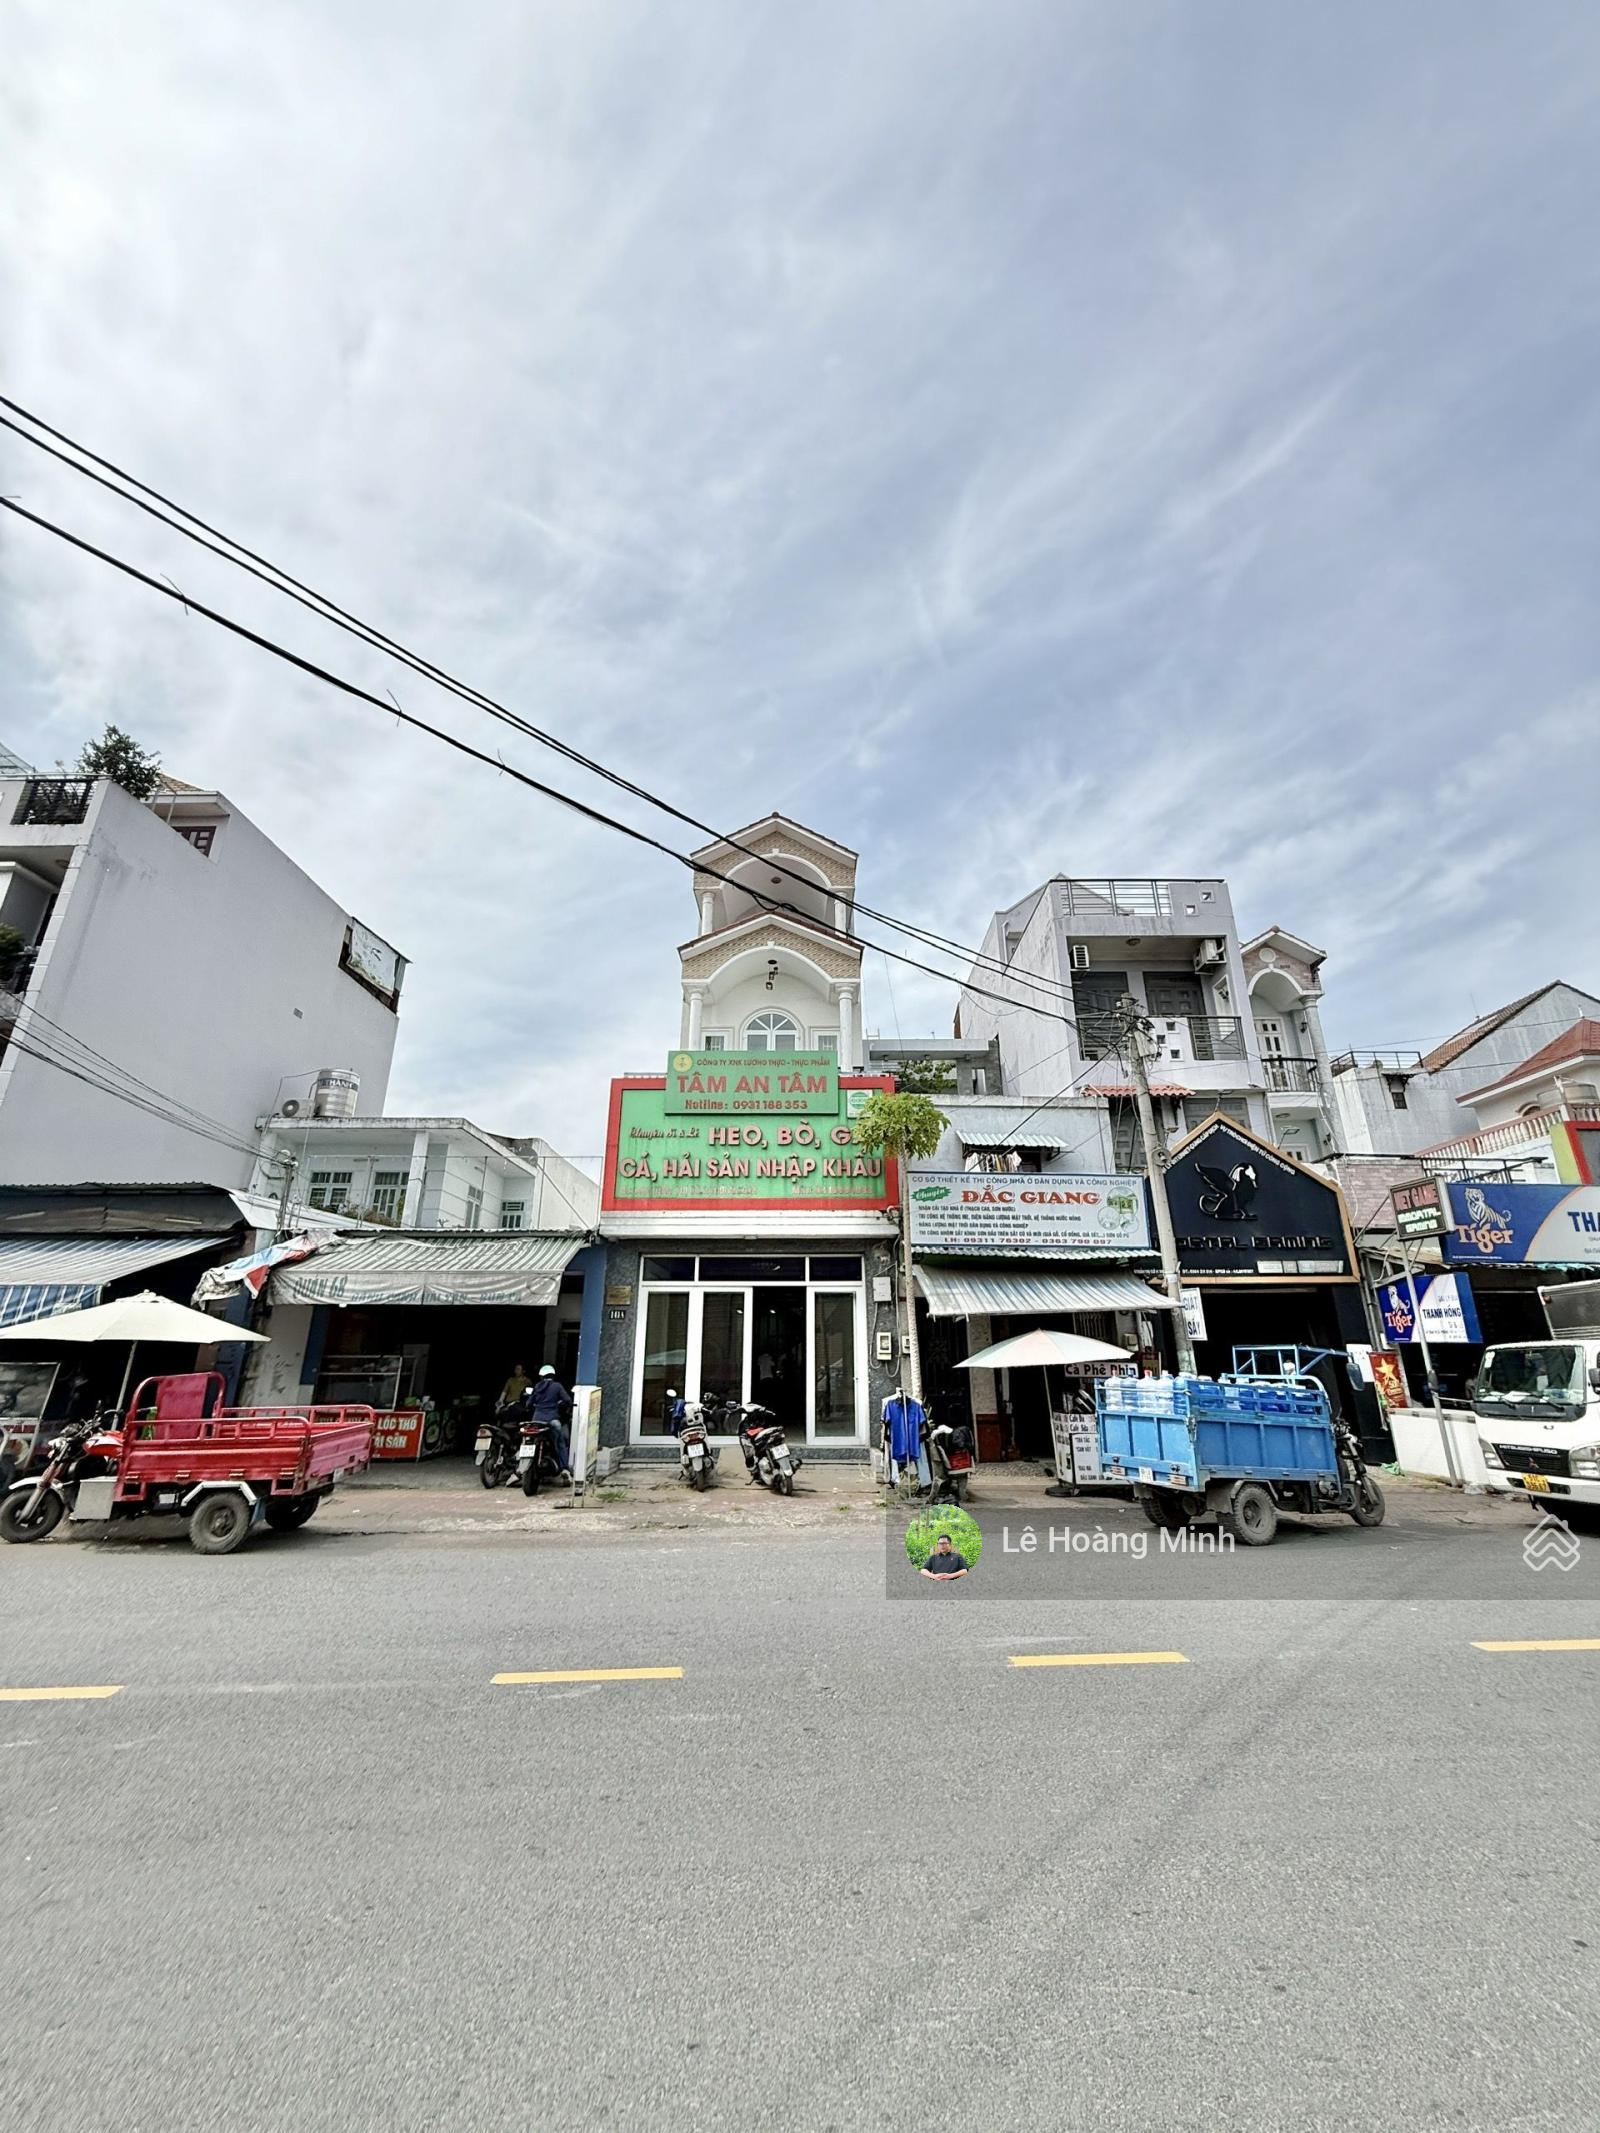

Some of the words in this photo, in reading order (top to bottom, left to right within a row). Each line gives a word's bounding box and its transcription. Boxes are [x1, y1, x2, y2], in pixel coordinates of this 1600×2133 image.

[697, 1058, 718, 1067] CÔNG
[719, 1058, 727, 1067] TY
[677, 1071, 727, 1093] TÂM
[734, 1075, 769, 1093] AN
[778, 1071, 828, 1093] TÂM
[708, 1125, 769, 1150] HEO,
[777, 1120, 821, 1149] BÒ,
[620, 1152, 658, 1182] CÁ,
[663, 1152, 701, 1178] HẢI
[707, 1152, 750, 1178] SẢN
[756, 1152, 816, 1183] NHẬP
[823, 1148, 881, 1178] KHẨU
[925, 1175, 936, 1183] SỞ
[938, 1175, 958, 1183] THIẾT
[961, 1175, 970, 1183] KẾ
[986, 1176, 1008, 1184] CÔNG
[1010, 1176, 1025, 1184] NHÀ
[1027, 1176, 1033, 1184] Ở
[1034, 1176, 1050, 1185] DÂN
[1052, 1178, 1073, 1187] DỤNG
[1074, 1177, 1085, 1185] VÀ
[1086, 1178, 1108, 1186] CÔNG
[1110, 1178, 1137, 1187] NGHIỆP
[962, 1184, 1015, 1203] ĐẮC
[1020, 1191, 1100, 1205] GIANG
[1567, 1211, 1600, 1232] TH
[1455, 1223, 1514, 1254] Tiger
[293, 1274, 329, 1298] QUÁN
[328, 1275, 348, 1298] 68
[1385, 1310, 1412, 1333] Tiger
[1422, 1308, 1443, 1318] THANH
[1066, 1364, 1080, 1375] Cà
[1084, 1363, 1106, 1376] Phê
[377, 1414, 396, 1430] LÓC
[372, 1432, 385, 1448] ẢI
